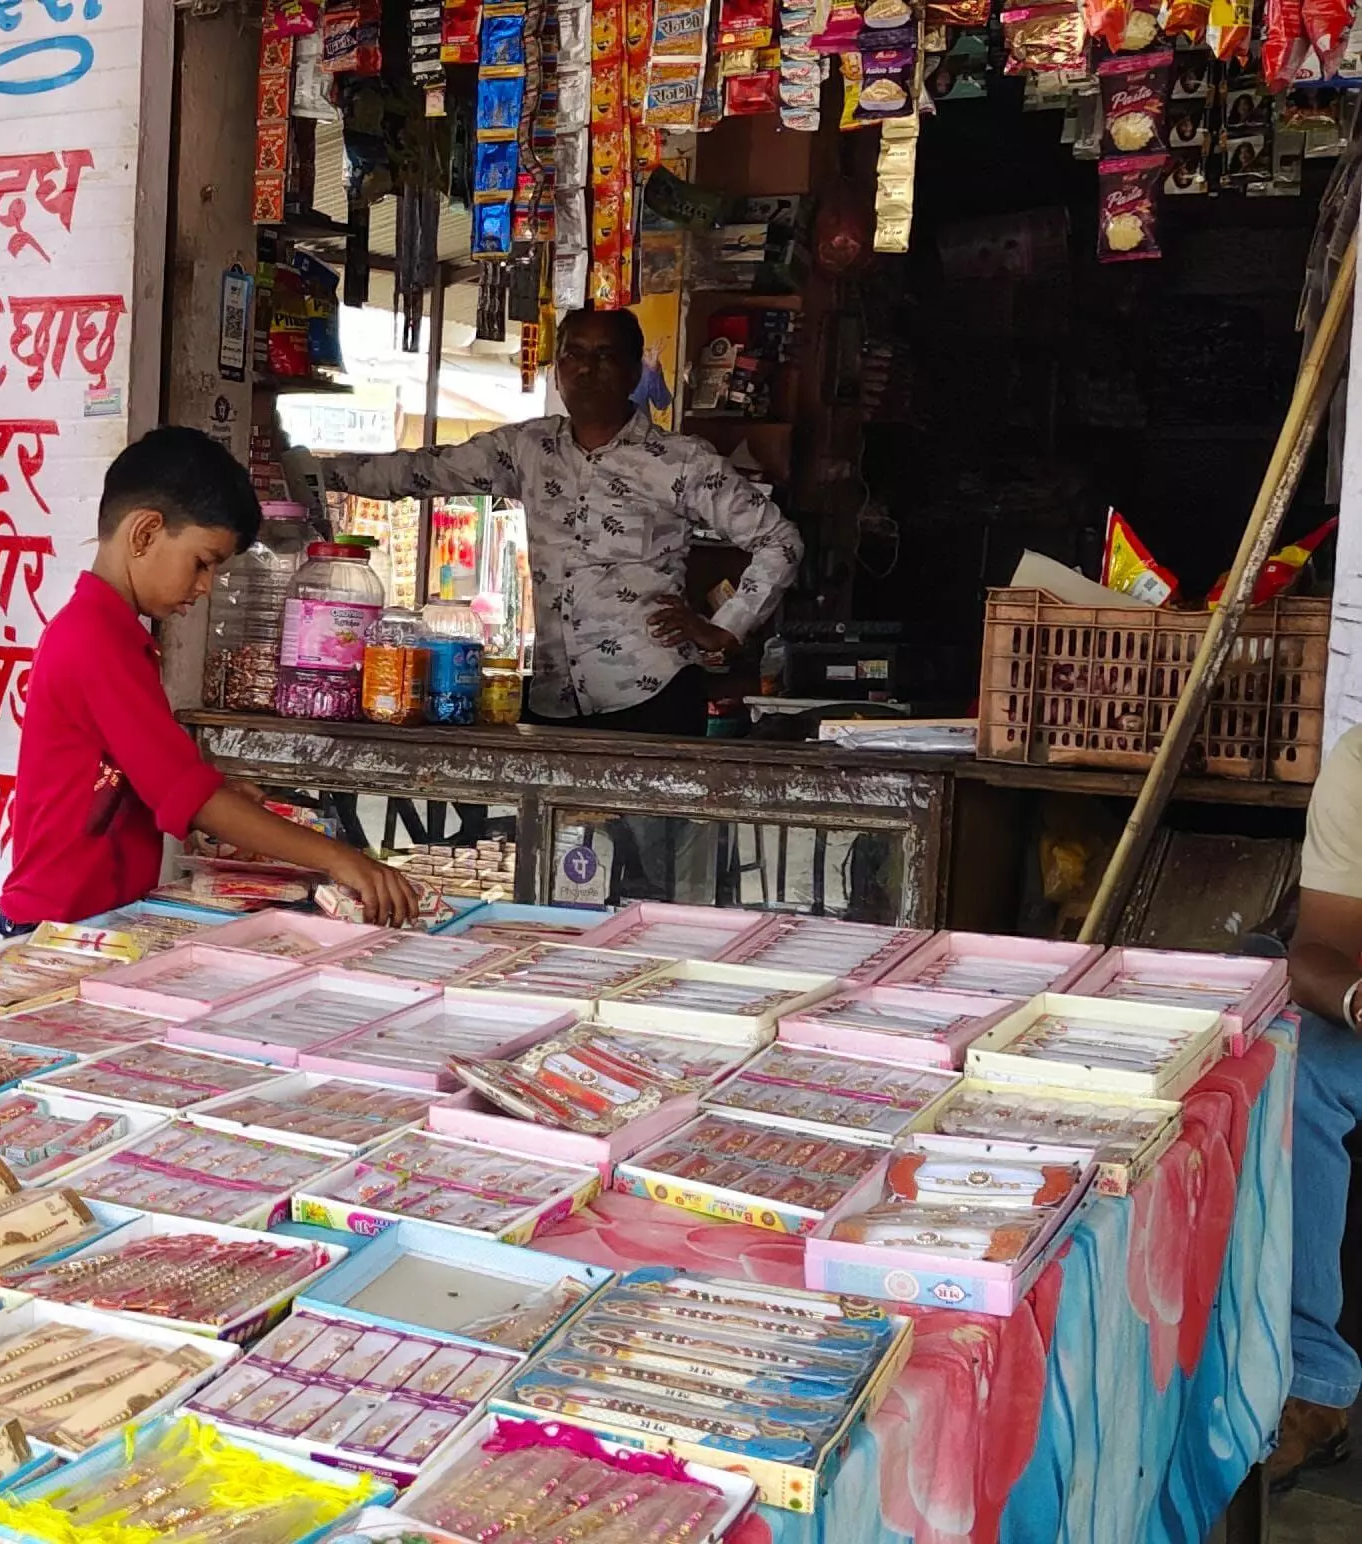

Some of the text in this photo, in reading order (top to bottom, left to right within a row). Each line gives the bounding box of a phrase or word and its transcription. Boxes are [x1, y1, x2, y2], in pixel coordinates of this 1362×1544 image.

[1111, 88, 1153, 109] Pasta
[1106, 186, 1144, 209] Pasta
[8, 294, 127, 392] छाछ
[706, 1203, 754, 1225] BALAJI
[938, 1287, 961, 1300] MR
